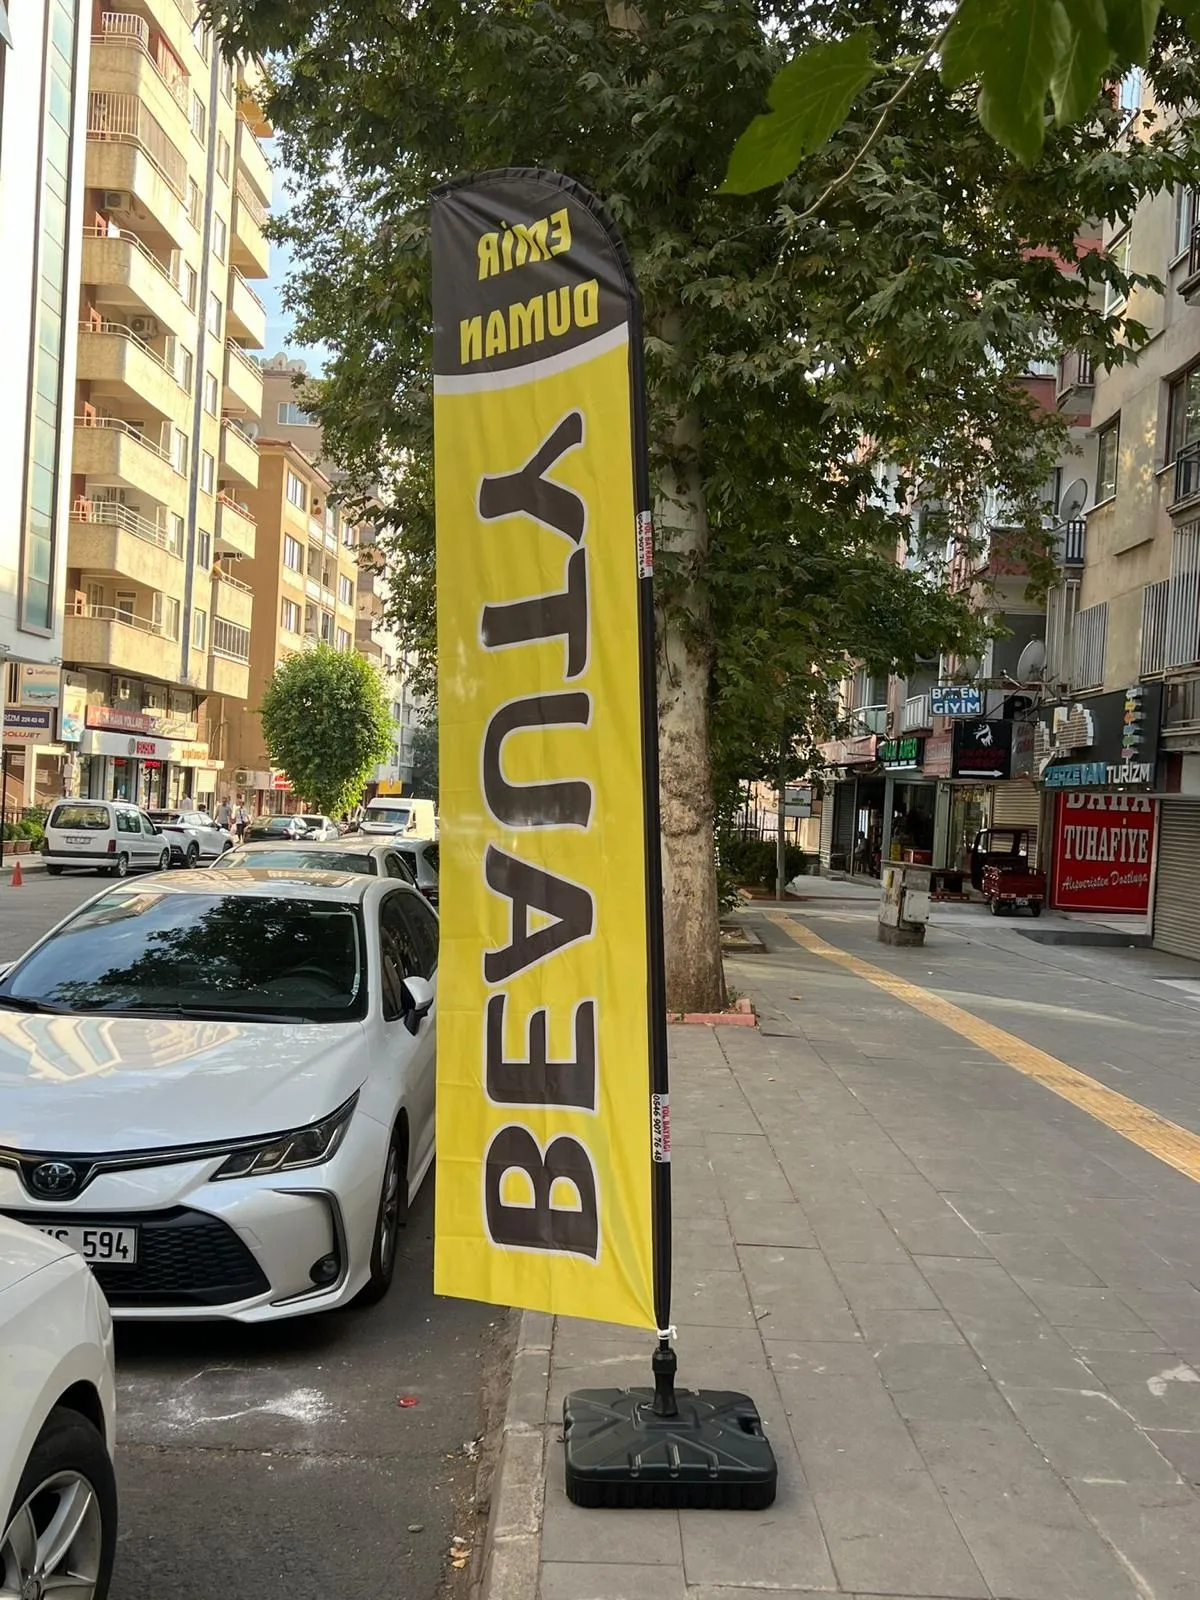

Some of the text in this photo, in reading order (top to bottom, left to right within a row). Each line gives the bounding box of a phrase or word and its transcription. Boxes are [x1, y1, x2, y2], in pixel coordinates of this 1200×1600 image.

[644, 522, 652, 535] YOL
[932, 700, 981, 715] GİYİM
[1107, 761, 1151, 784] TURİZM
[1063, 817, 1149, 863] TUHAFİYE
[662, 1104, 670, 1119] YOL
[653, 1094, 663, 1161] 0546 907 76 48
[83, 1230, 129, 1259] 594
